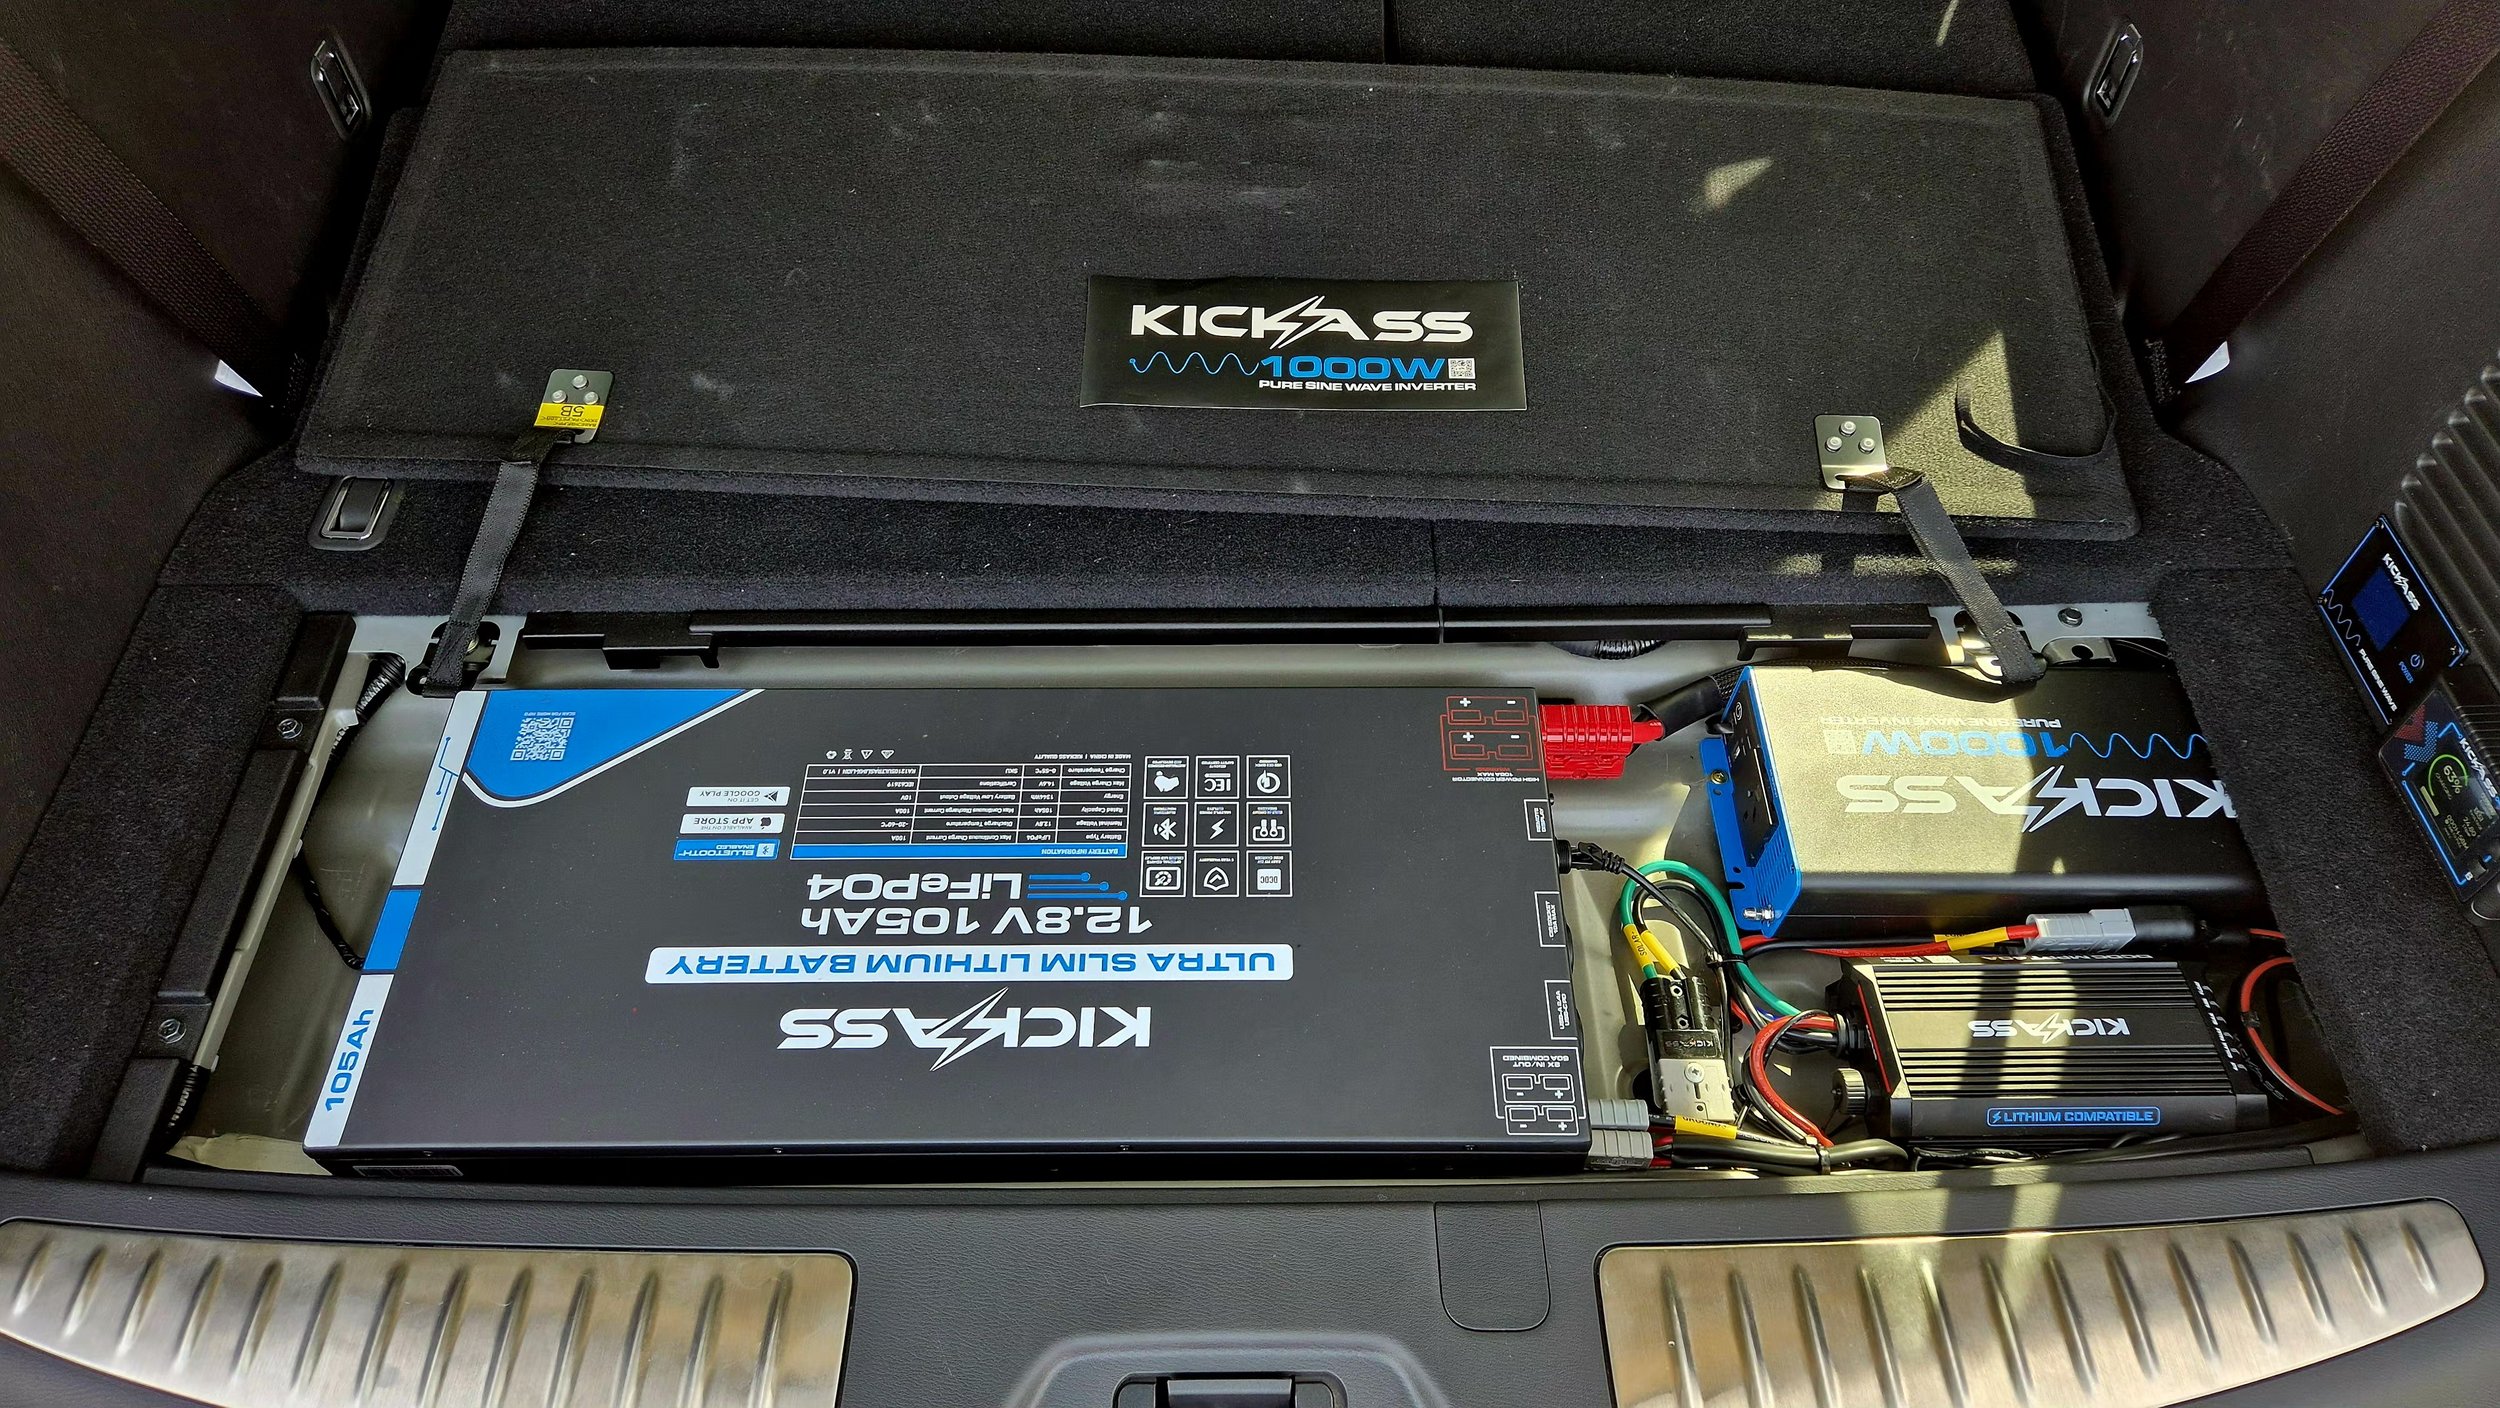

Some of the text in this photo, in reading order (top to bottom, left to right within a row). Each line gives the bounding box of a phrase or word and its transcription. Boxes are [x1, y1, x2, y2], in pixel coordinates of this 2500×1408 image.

[1130, 295, 1473, 350] KICKASS
[1260, 355, 1445, 380] 1000W
[1258, 380, 1477, 393] PURE SINE WAVE INVERTER
[560, 405, 586, 418] 5B
[2382, 553, 2420, 611] KICKASS
[2398, 661, 2413, 684] POWER
[1862, 730, 2069, 759] 1000W
[1106, 766, 1126, 774] Charge
[2459, 738, 2497, 798] KICKASS
[1091, 779, 1113, 787] Charge
[1203, 778, 1232, 792] IEC
[2442, 765, 2461, 795] 63%
[1103, 792, 1125, 800] Energy
[1836, 765, 2239, 833] KICKASS
[693, 817, 755, 825] APP STORE
[1081, 805, 1106, 814] Capacity
[1076, 819, 1098, 827] Voltage
[1086, 833, 1100, 841] Type
[806, 873, 1024, 902] LiFePO4
[799, 906, 1155, 936] 12.8V 105Ah
[666, 953, 1277, 976] ULTRA SLIM LITHIUM BATTERY
[778, 988, 1153, 1072] KICKASS
[1967, 1013, 2129, 1045] KICKASS
[325, 1008, 375, 1112] 105Ah
[2003, 1110, 2153, 1122] LITHIUM COMPATIBLE
